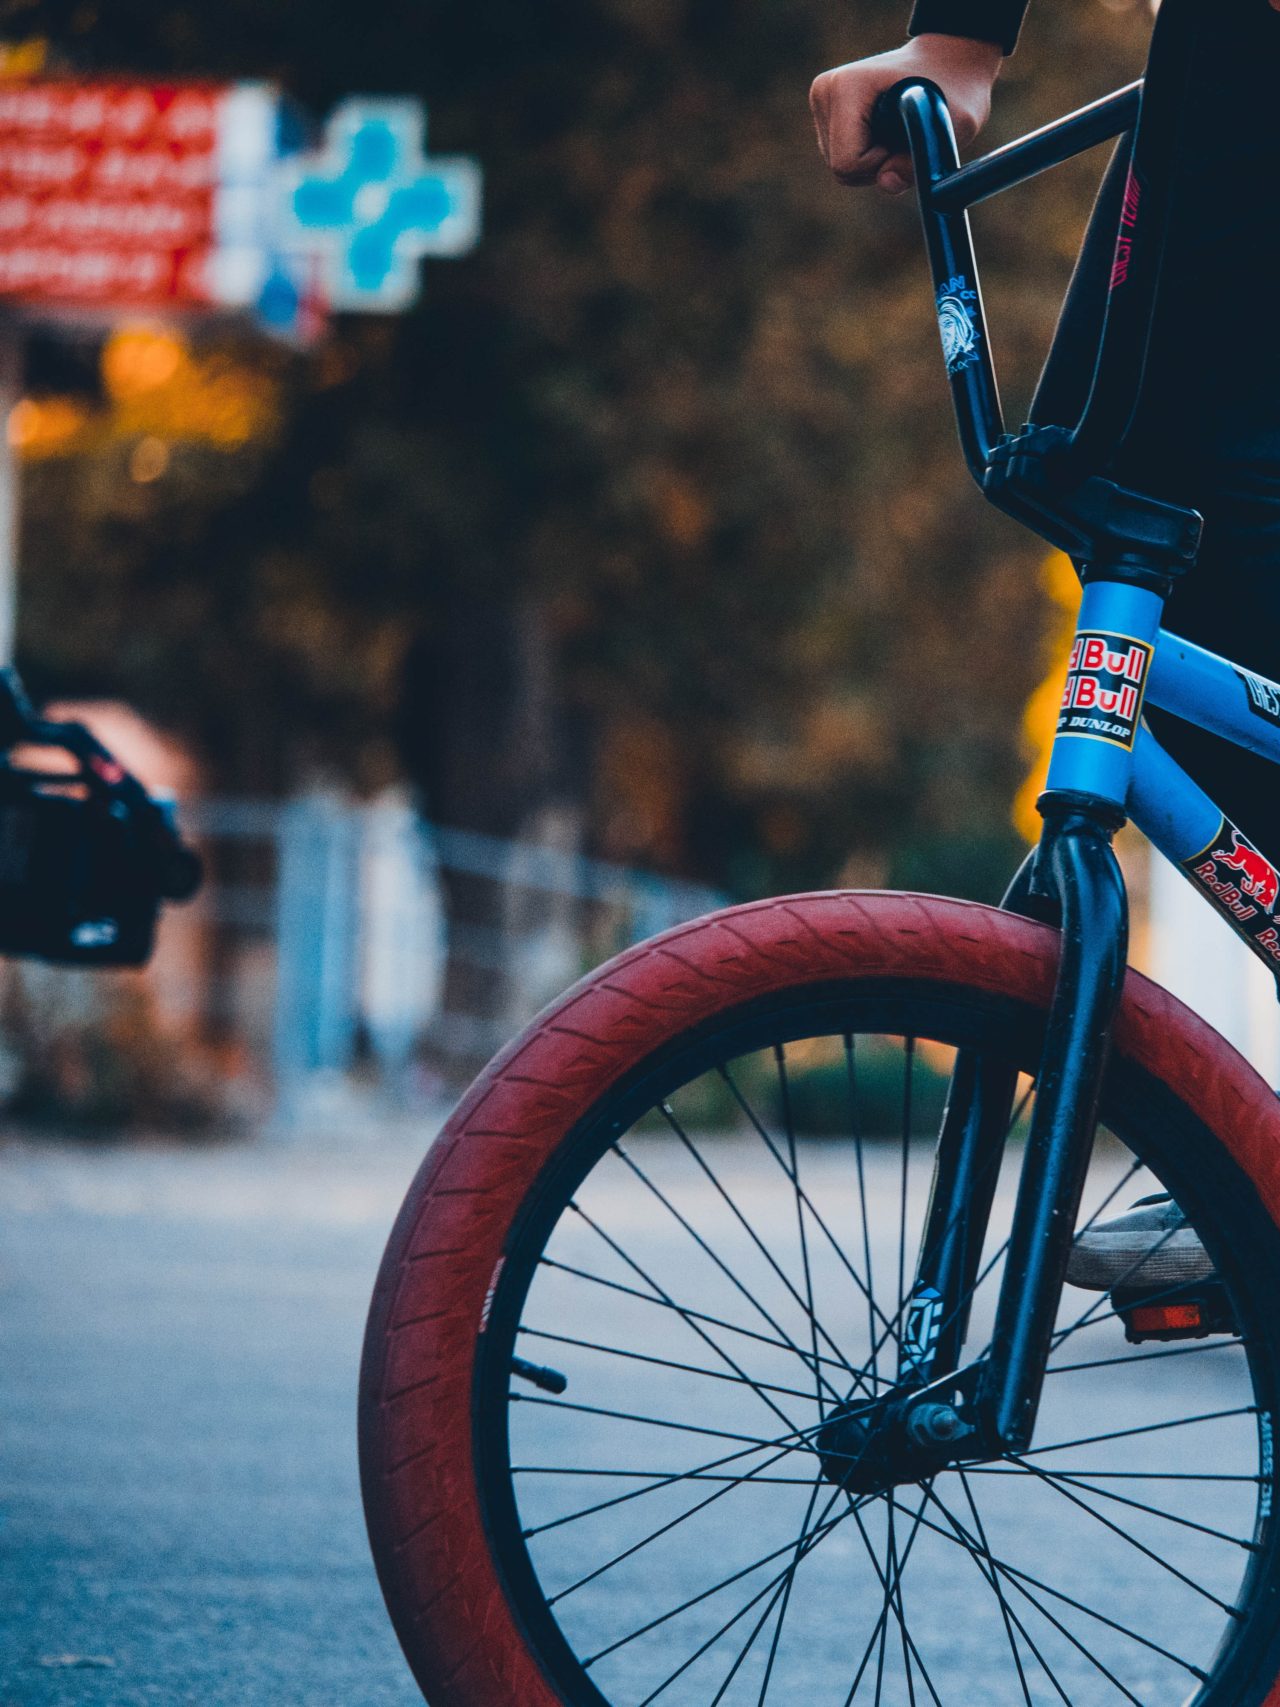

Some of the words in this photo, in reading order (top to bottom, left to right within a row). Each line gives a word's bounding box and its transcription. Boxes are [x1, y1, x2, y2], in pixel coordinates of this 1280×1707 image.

[1080, 637, 1146, 684] Bull
[1072, 675, 1138, 722] Bull
[1069, 716, 1131, 738] DUNLOP
[1261, 1412, 1272, 1516] MISSON
